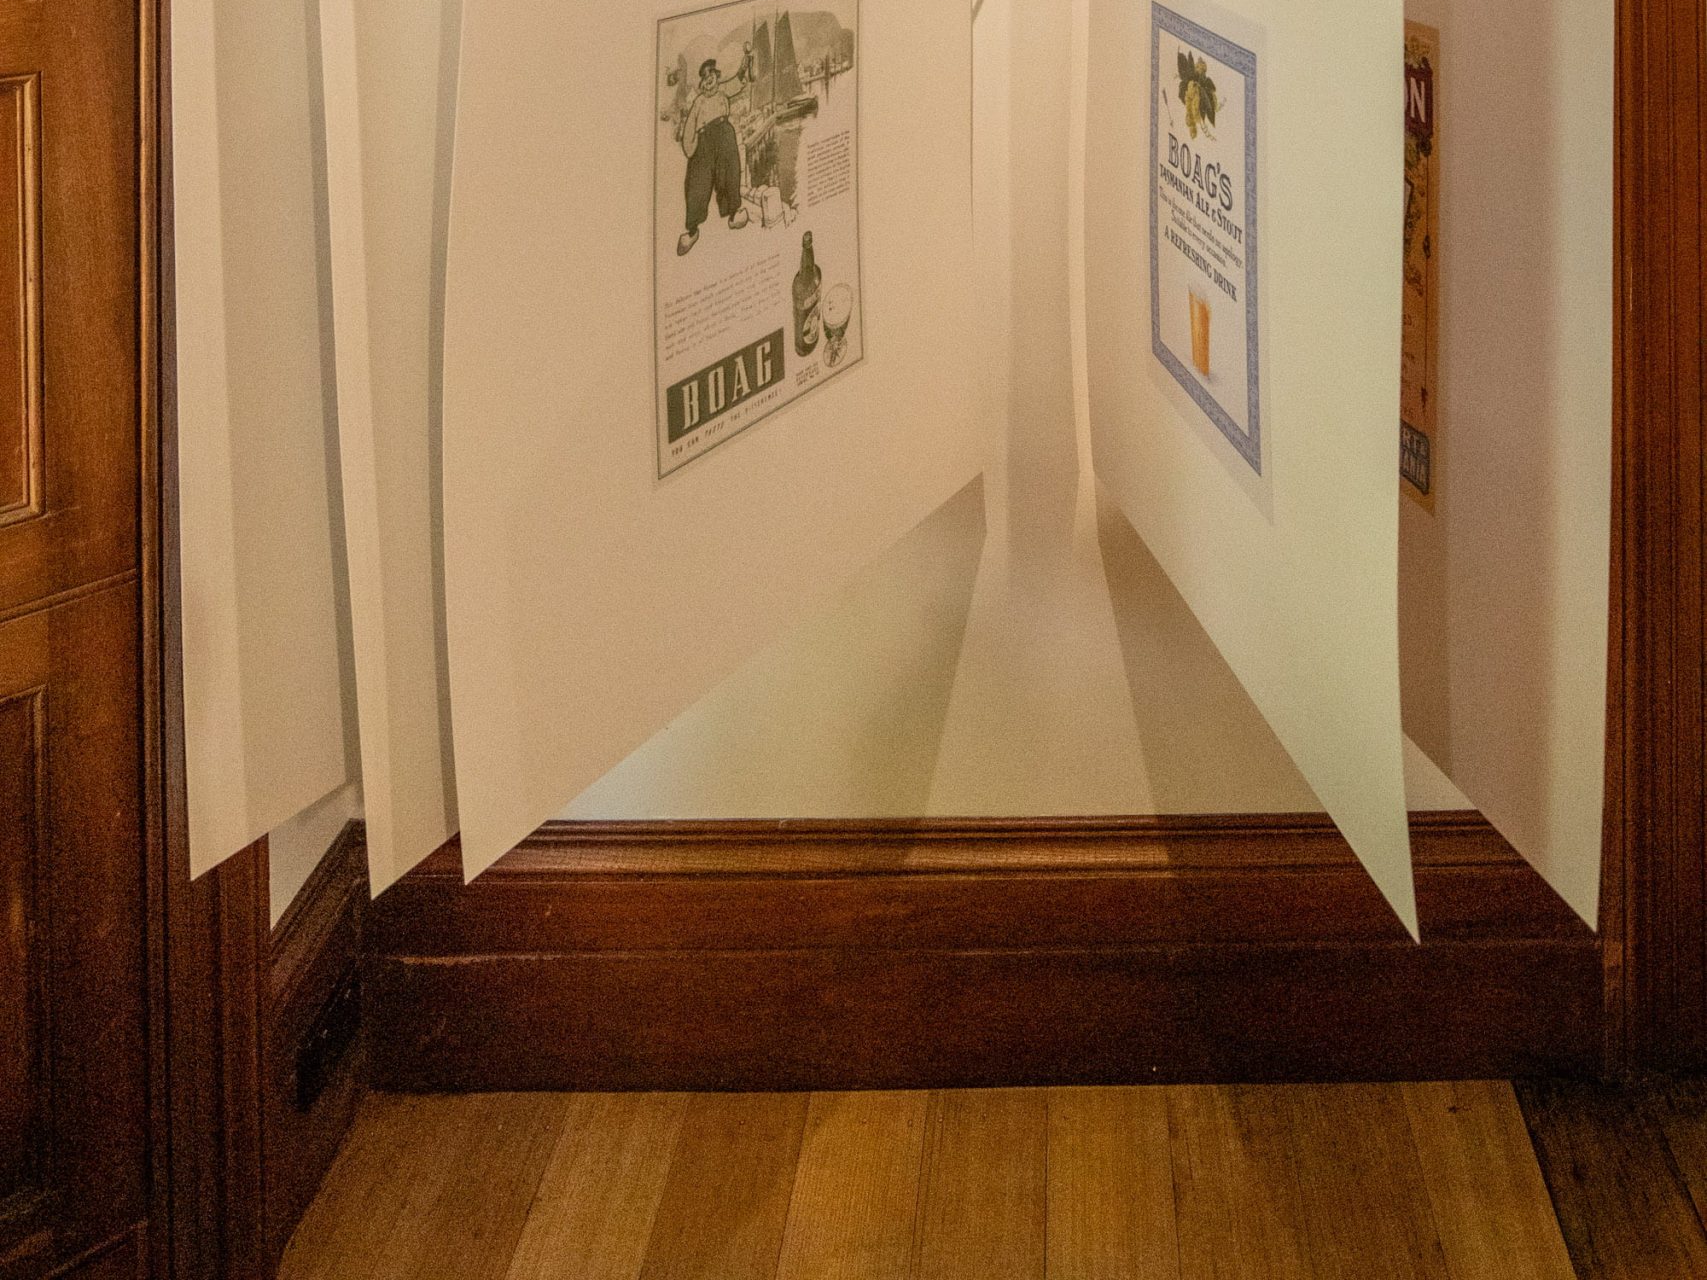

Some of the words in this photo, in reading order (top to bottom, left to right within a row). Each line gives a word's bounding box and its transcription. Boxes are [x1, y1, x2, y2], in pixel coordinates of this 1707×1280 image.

[1159, 163, 1194, 204] TASMANIAN
[1168, 132, 1233, 212] BOAG'S
[1164, 224, 1170, 240] A
[1170, 228, 1212, 279] REFRESHING
[1213, 267, 1237, 302] DRINK
[682, 341, 772, 430] BOAG
